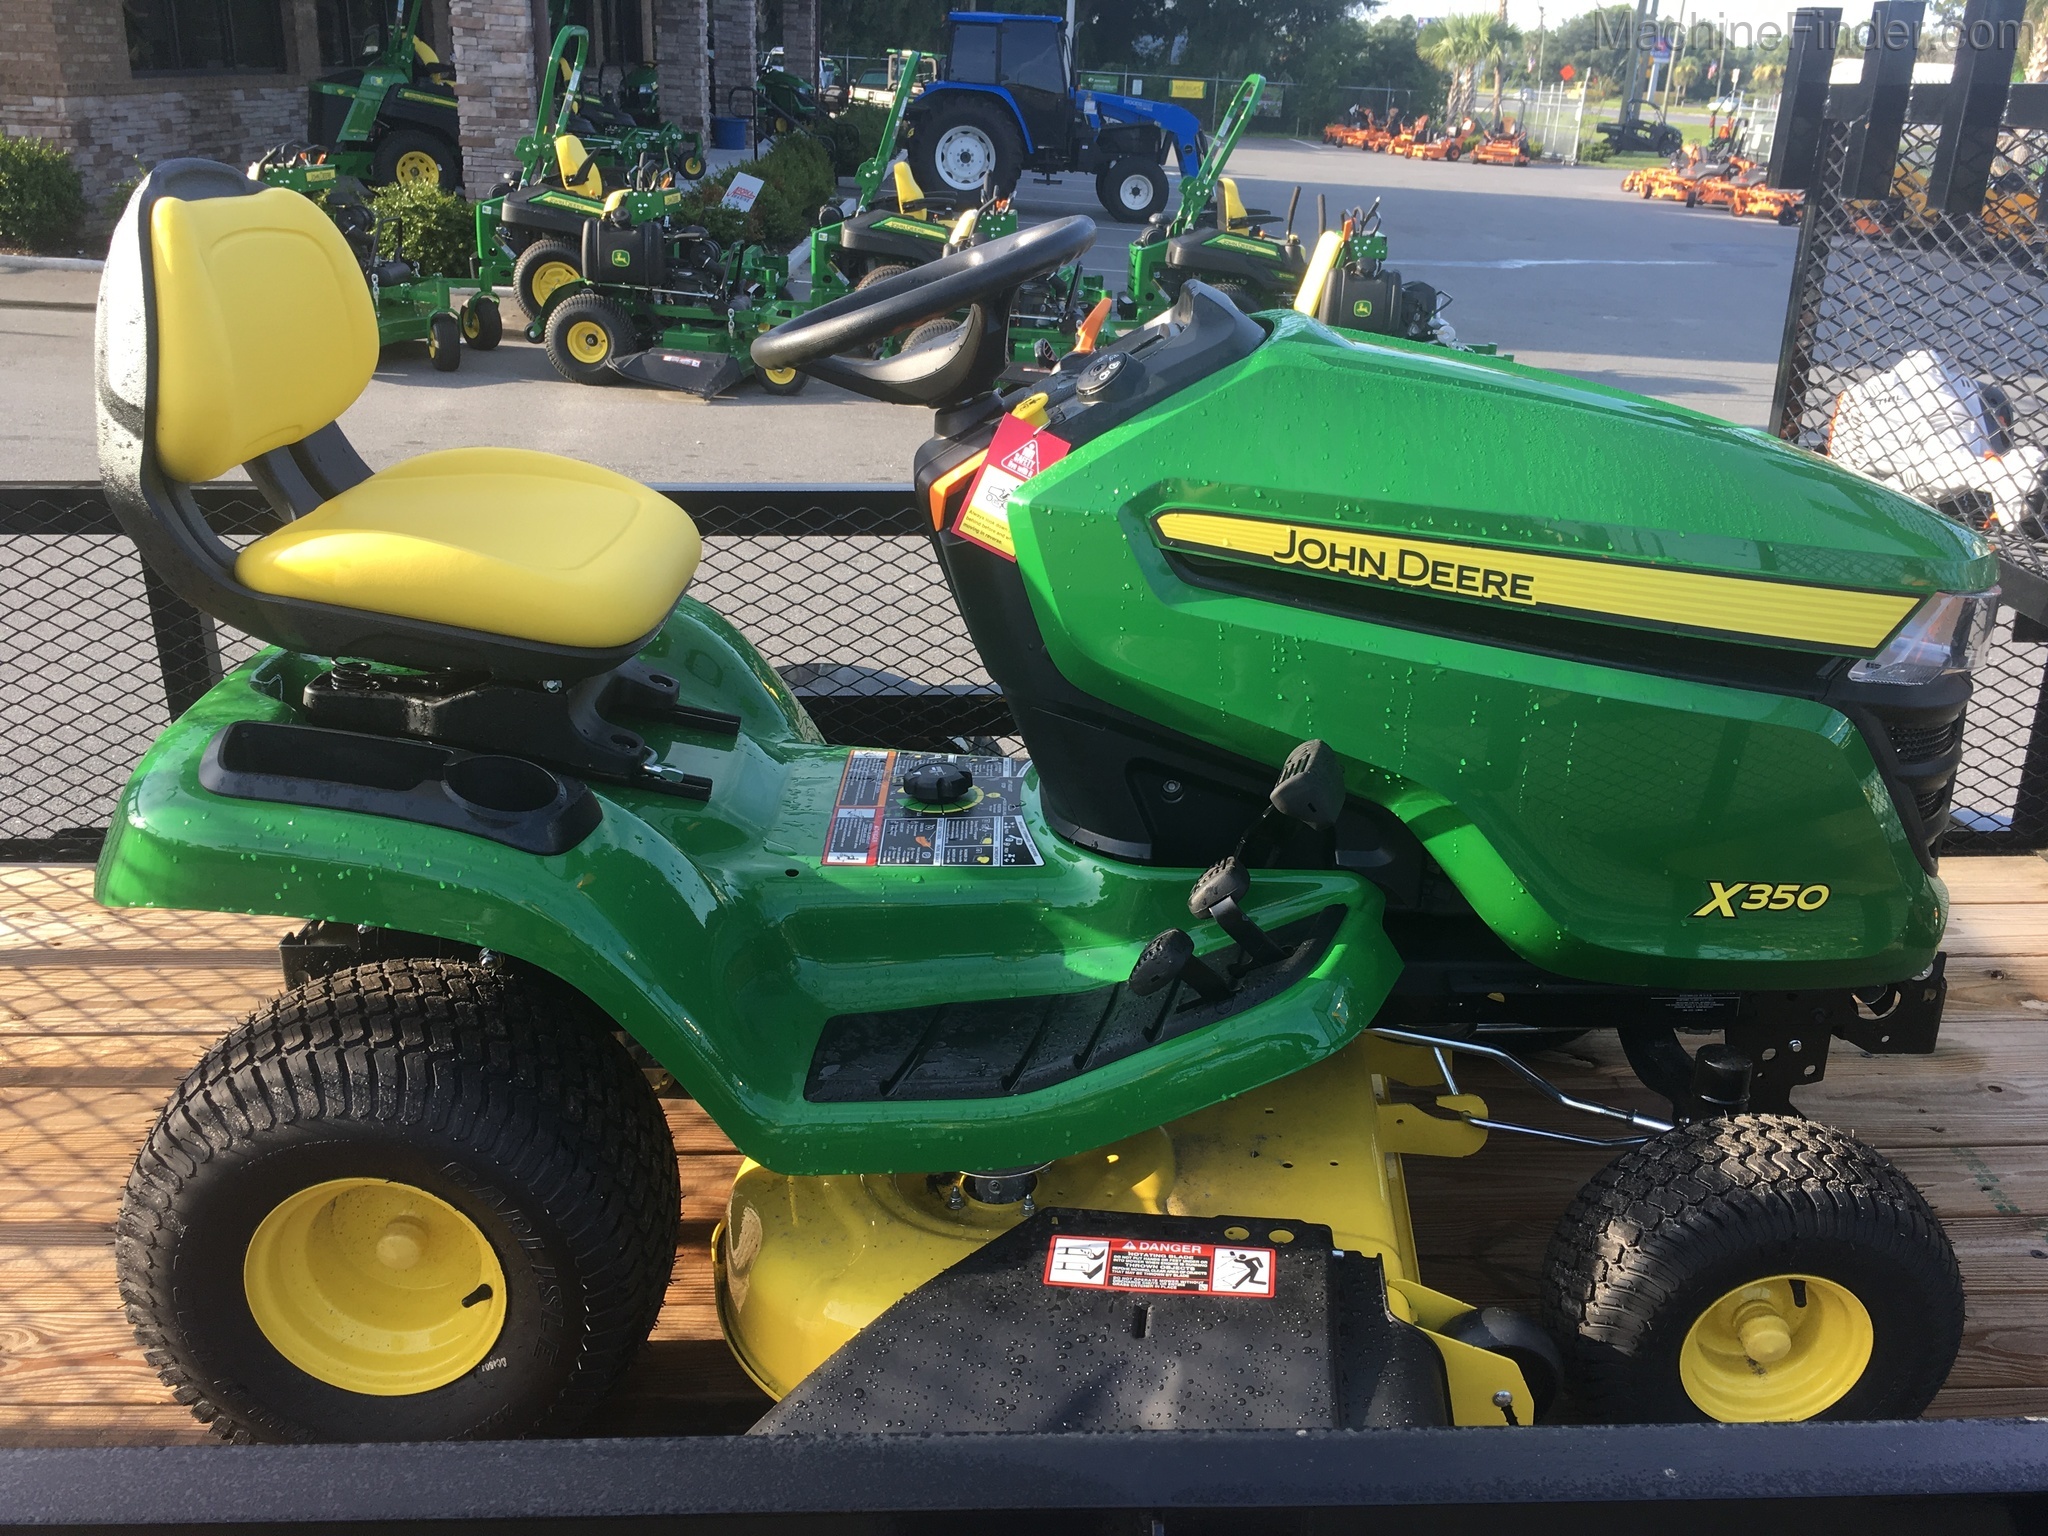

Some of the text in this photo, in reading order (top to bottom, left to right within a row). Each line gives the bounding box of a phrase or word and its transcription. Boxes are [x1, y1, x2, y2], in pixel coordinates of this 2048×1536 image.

[1273, 529, 1534, 601] JOHN DEERE
[1691, 880, 1831, 919] X350
[1139, 1242, 1202, 1253] DANGER
